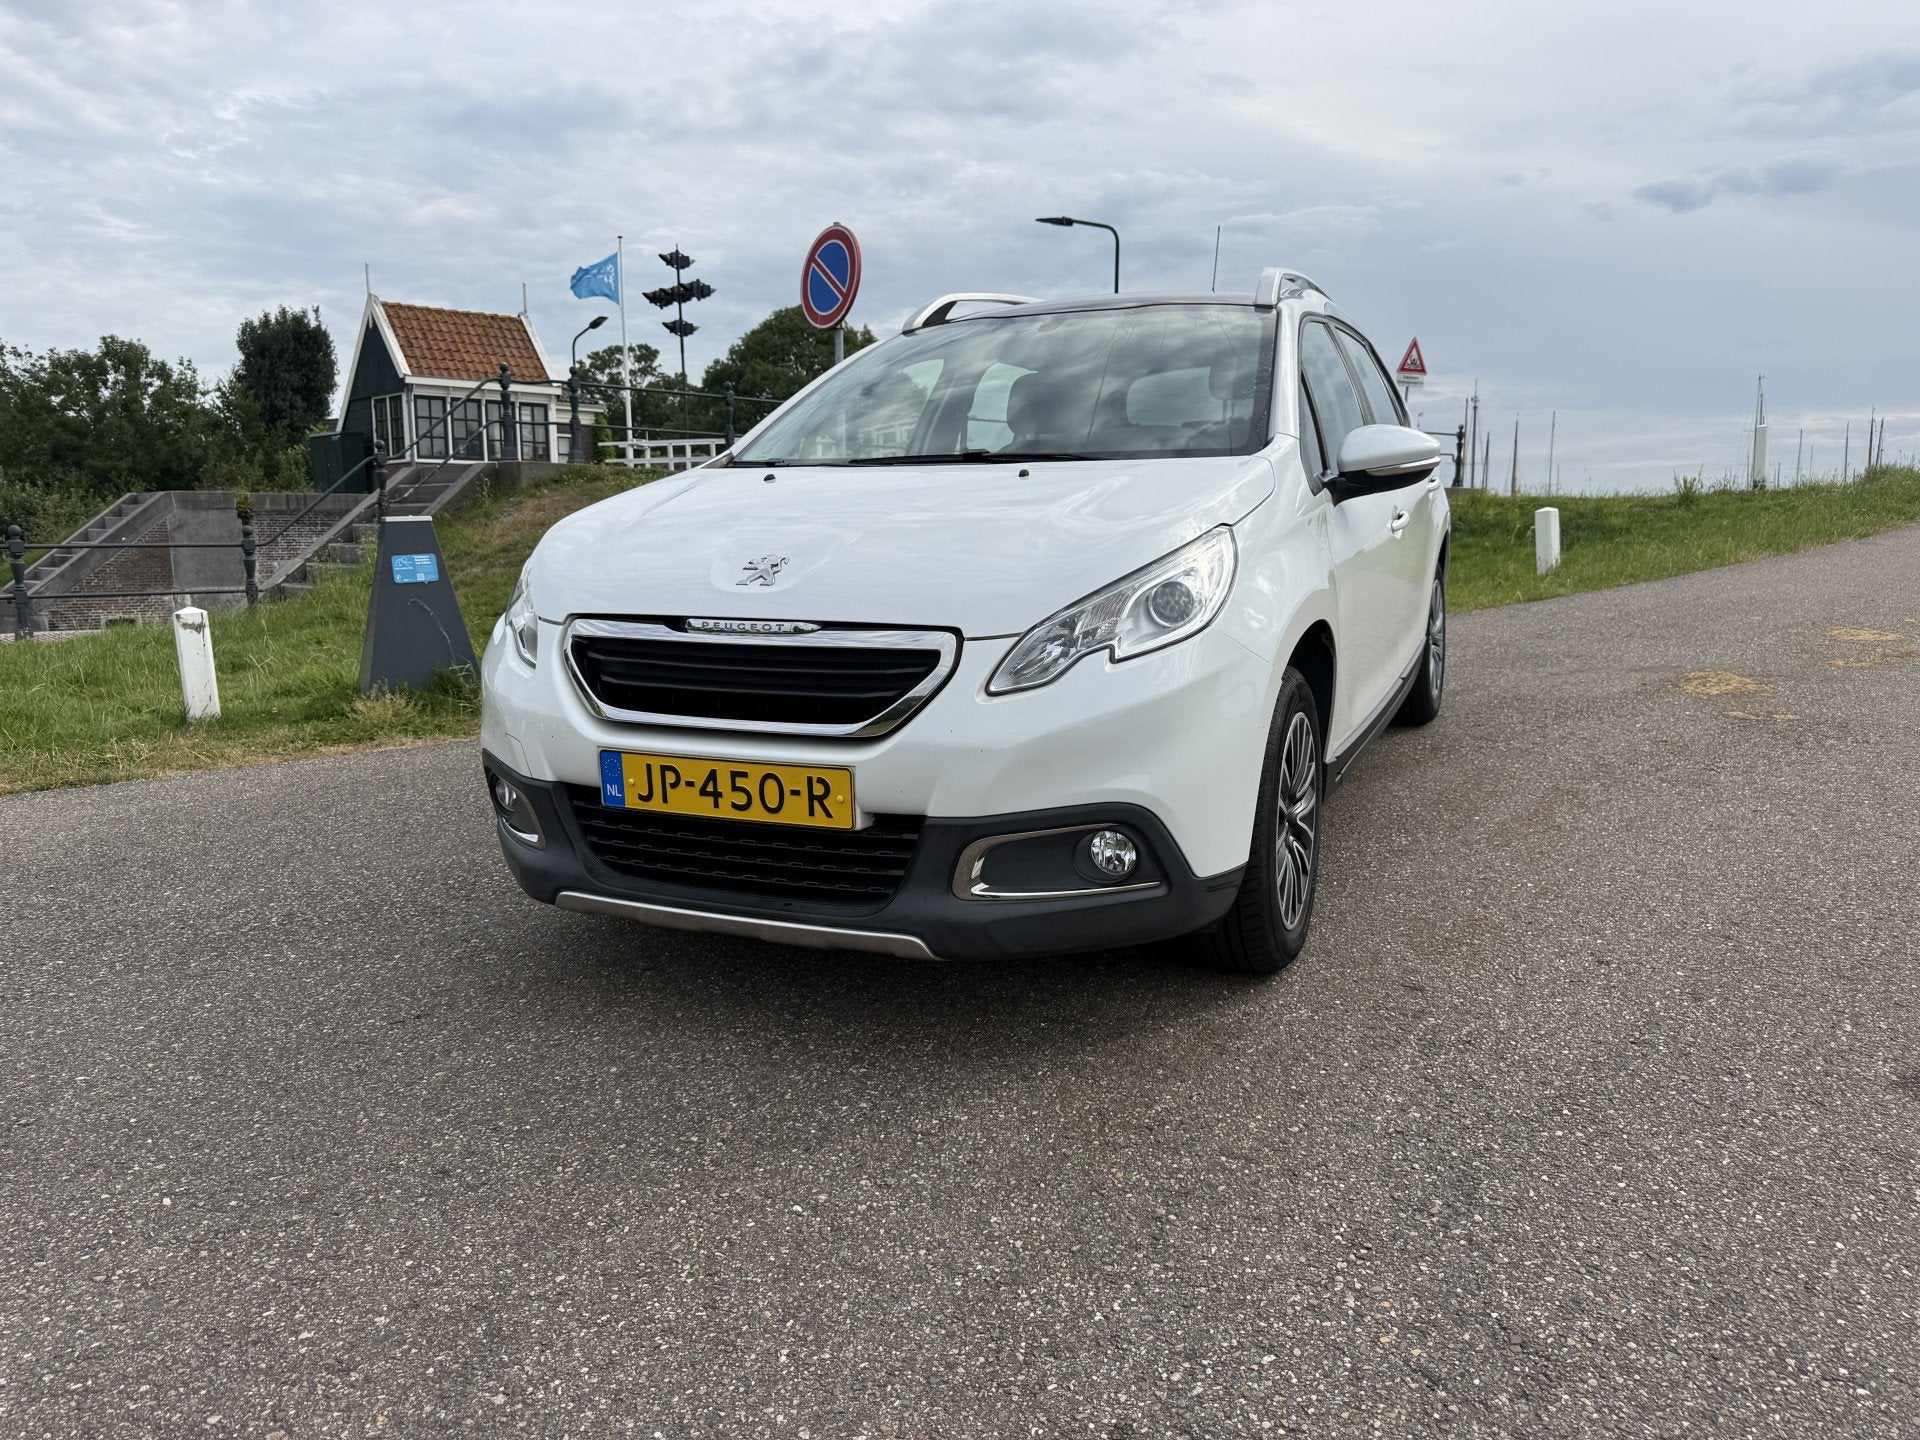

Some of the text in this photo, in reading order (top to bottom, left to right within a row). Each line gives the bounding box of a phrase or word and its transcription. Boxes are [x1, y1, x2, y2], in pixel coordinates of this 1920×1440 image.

[701, 621, 785, 632] PEUGEOT
[606, 783, 622, 797] NL
[637, 762, 834, 819] JP-450-R
